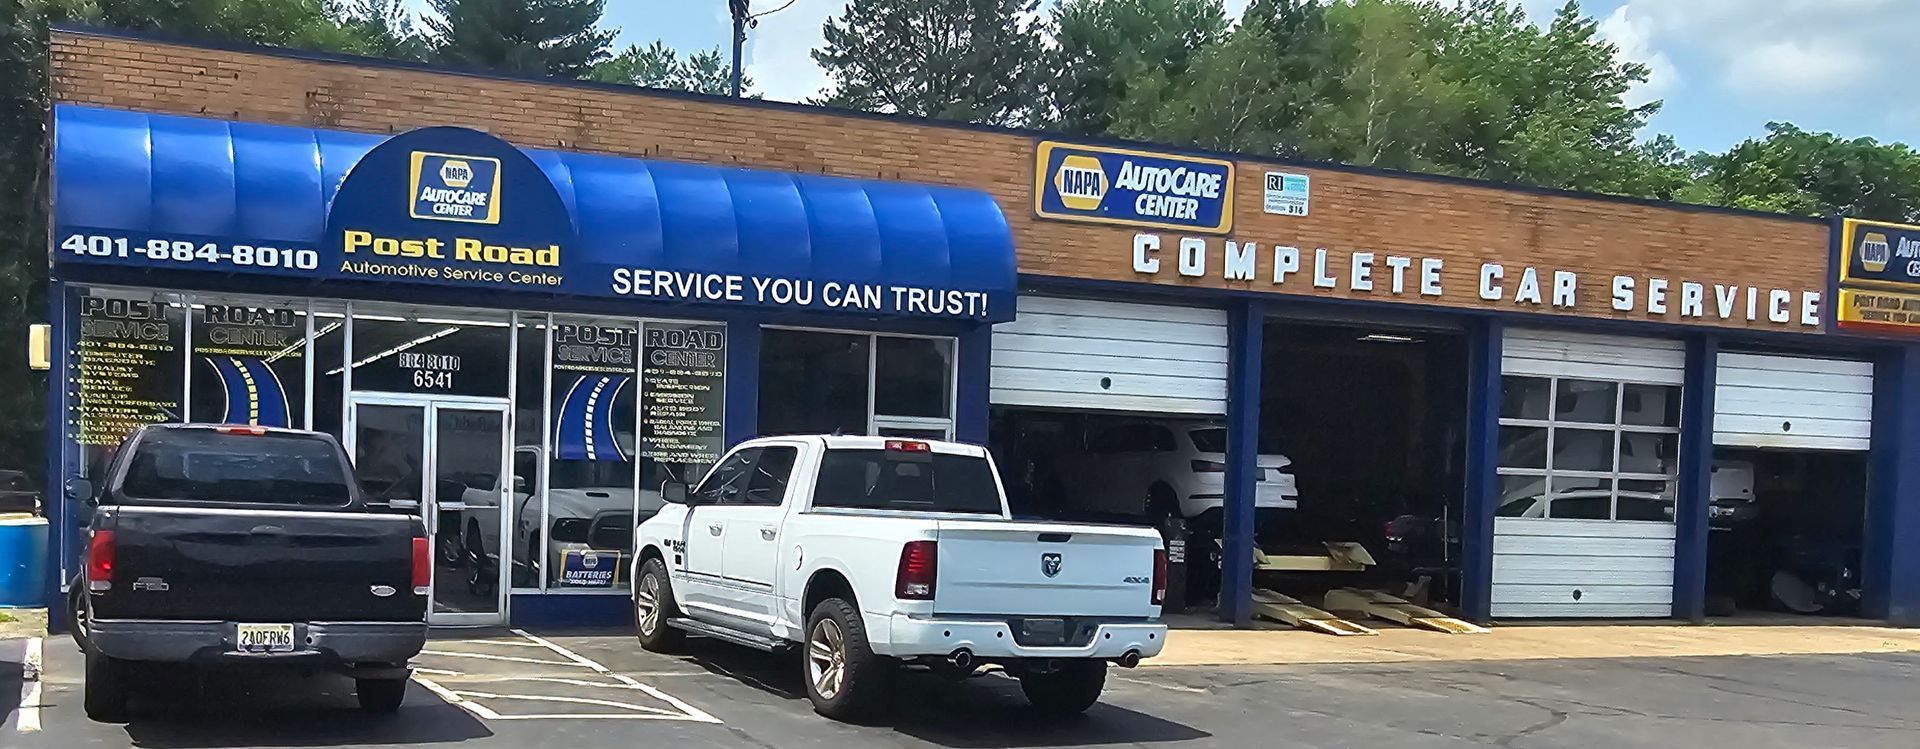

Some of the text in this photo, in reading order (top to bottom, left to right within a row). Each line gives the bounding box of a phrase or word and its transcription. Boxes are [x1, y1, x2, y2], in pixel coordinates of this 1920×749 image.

[445, 166, 469, 181] NAPA
[1063, 169, 1101, 197] NAPA
[1268, 176, 1282, 190] RI
[432, 203, 472, 217] CENTER
[1135, 194, 1199, 220] CENTER
[61, 234, 318, 270] 401-884-8010
[344, 230, 560, 267] Post Road
[340, 260, 563, 286] Automotive Service Center
[1133, 234, 1821, 326] COMPLETE CAR SERVICE
[612, 268, 988, 317] SERVICE YOU CAN TRUST!
[80, 295, 296, 328] POST ROAD
[81, 319, 288, 346] SERVICE CENTER
[555, 324, 724, 350] POST ROAD
[400, 353, 425, 368] 884
[558, 345, 716, 368] SERVICE CENTER
[413, 369, 452, 389] 6541
[565, 570, 613, 579] BATTERIES
